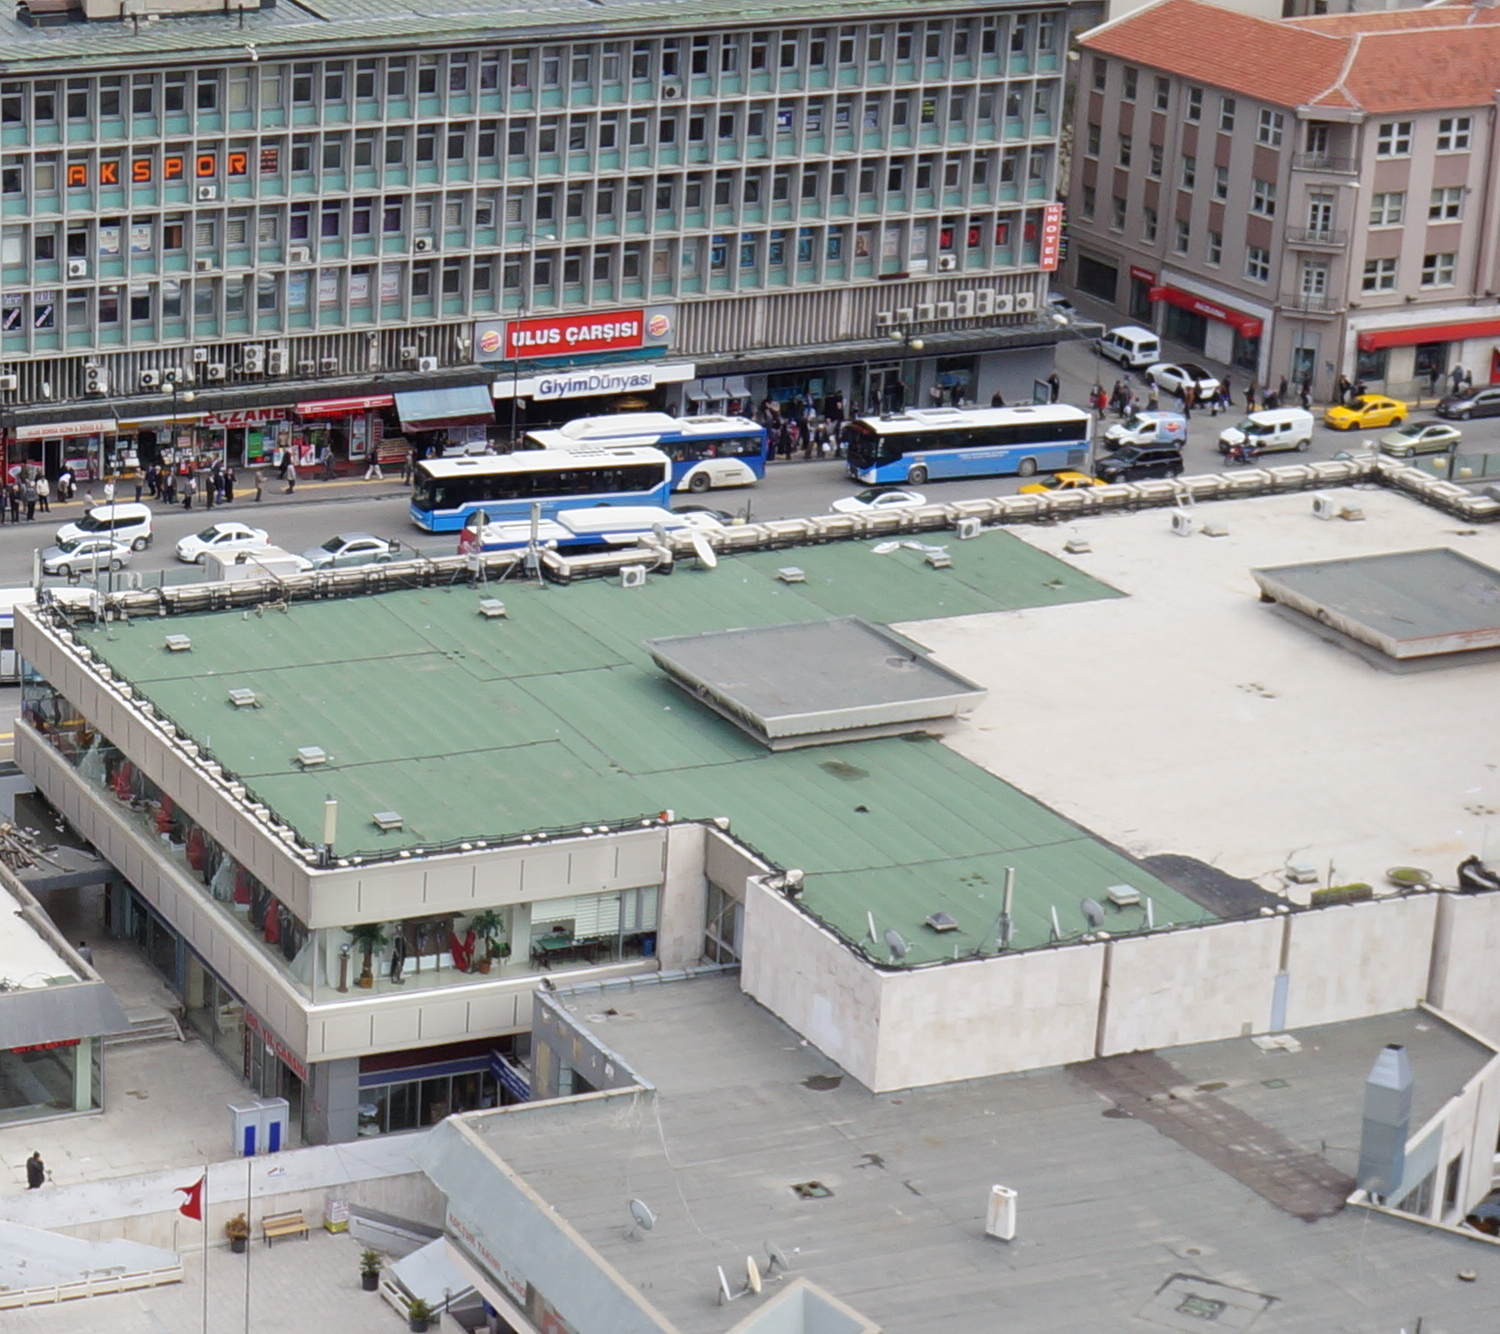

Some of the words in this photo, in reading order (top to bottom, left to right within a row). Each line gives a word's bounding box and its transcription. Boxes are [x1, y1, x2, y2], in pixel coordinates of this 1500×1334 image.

[1043, 214, 1059, 265] NOTER
[511, 325, 561, 348] ULUS
[564, 320, 639, 345] ÇARŞISI
[539, 373, 653, 396] GiyimDünyası
